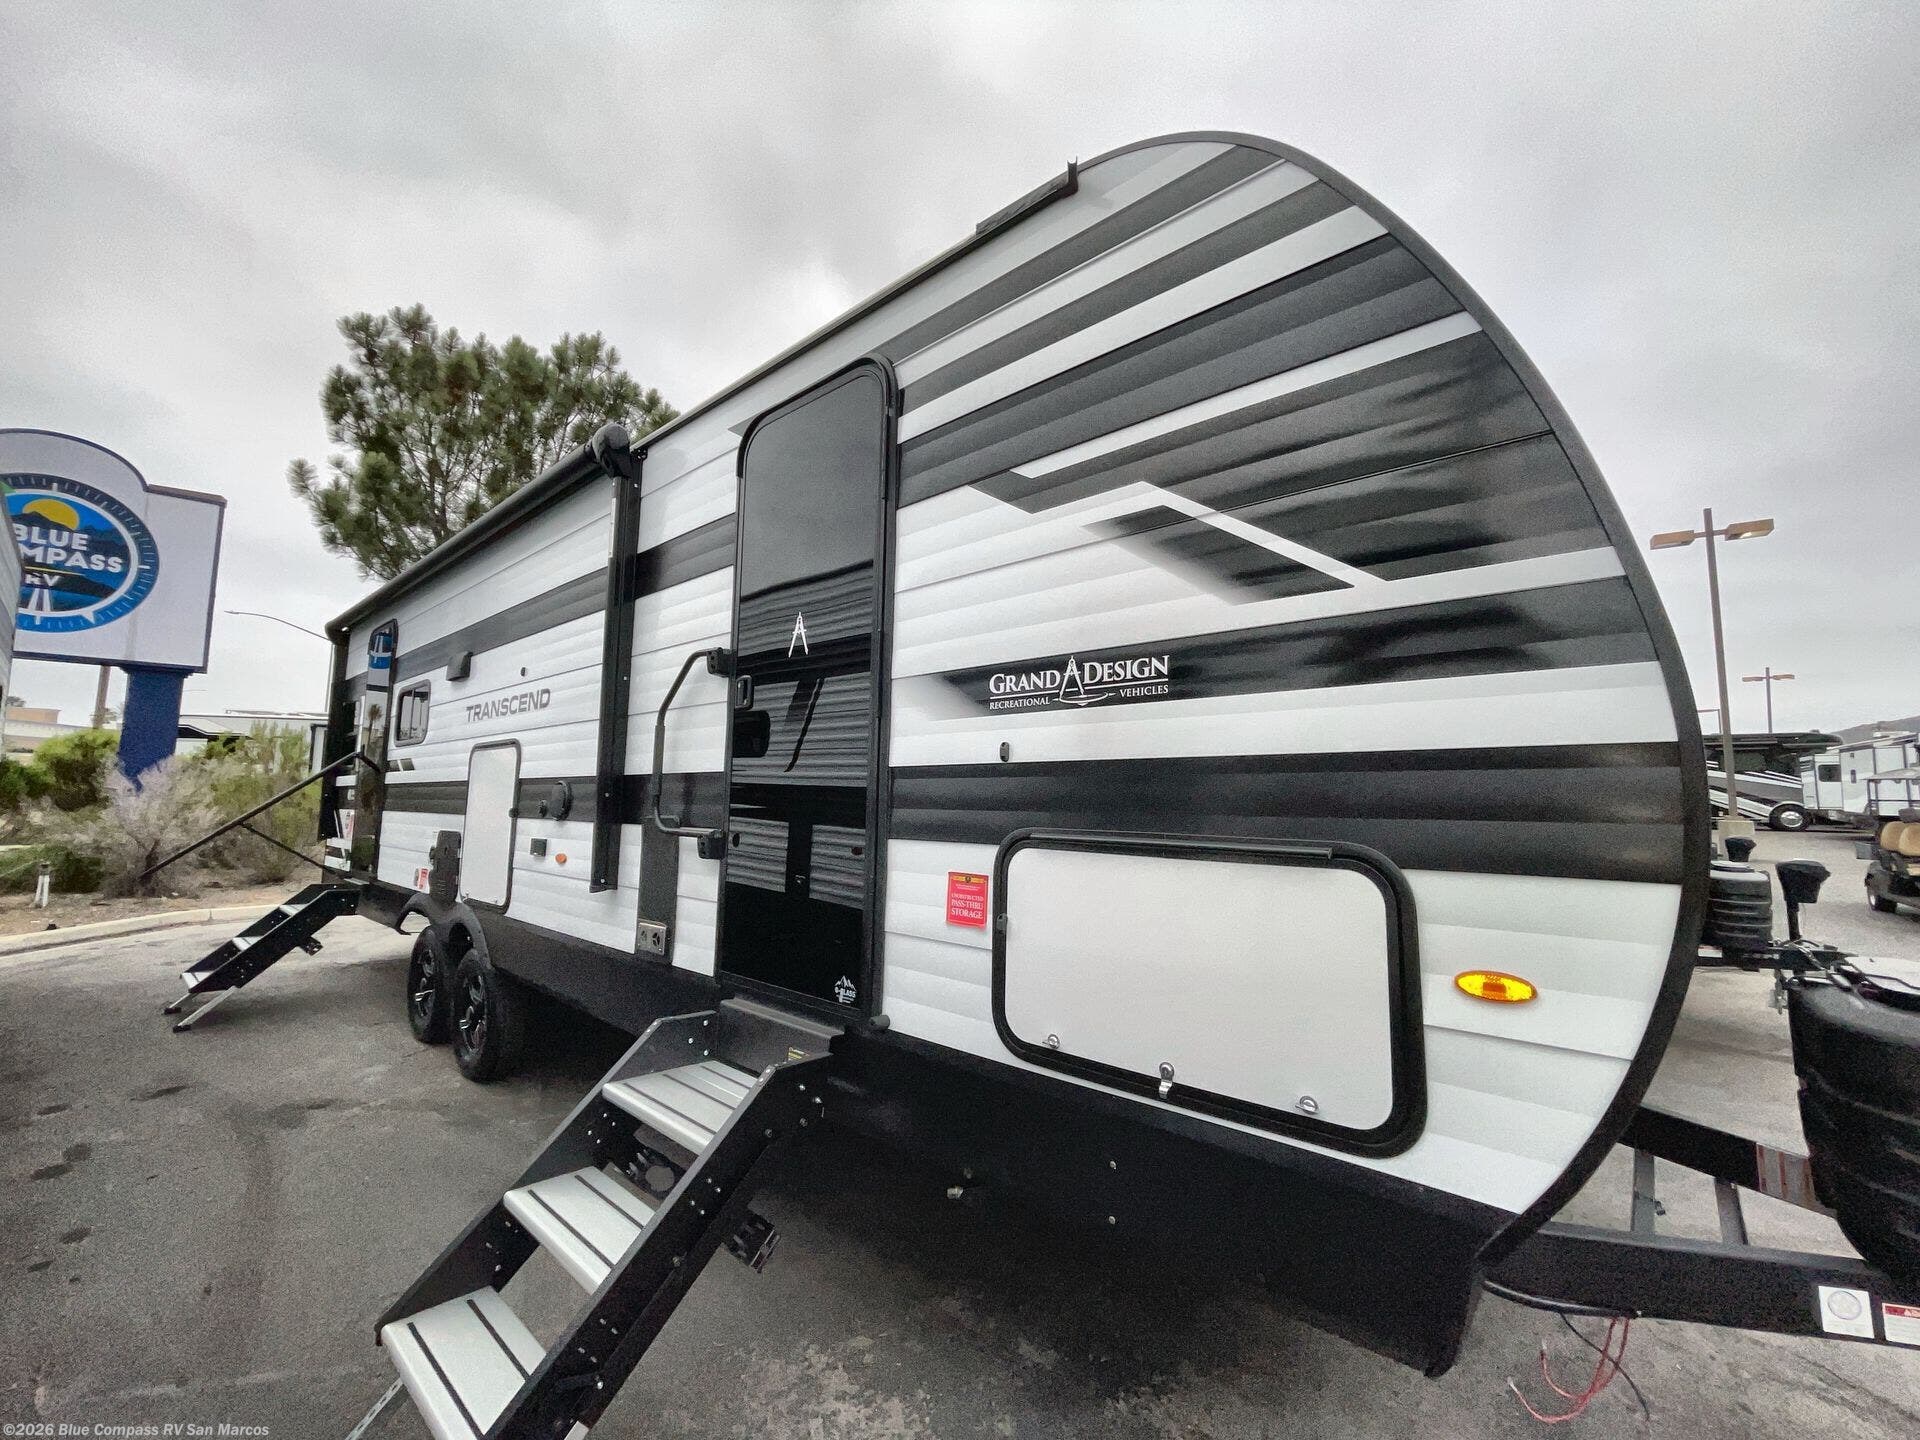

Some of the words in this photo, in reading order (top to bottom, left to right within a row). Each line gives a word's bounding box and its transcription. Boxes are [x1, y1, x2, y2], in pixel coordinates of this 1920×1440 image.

[13, 523, 89, 551] BLUE
[18, 544, 123, 574] MPASS
[25, 572, 61, 587] RV
[989, 669, 1061, 694] GRAND
[1083, 655, 1170, 684] DESIGN
[466, 688, 551, 722] TRANSCEND
[989, 696, 1050, 710] RECREATIONAL
[1119, 684, 1169, 698] VEHICLES
[951, 908, 984, 919] STORAGE
